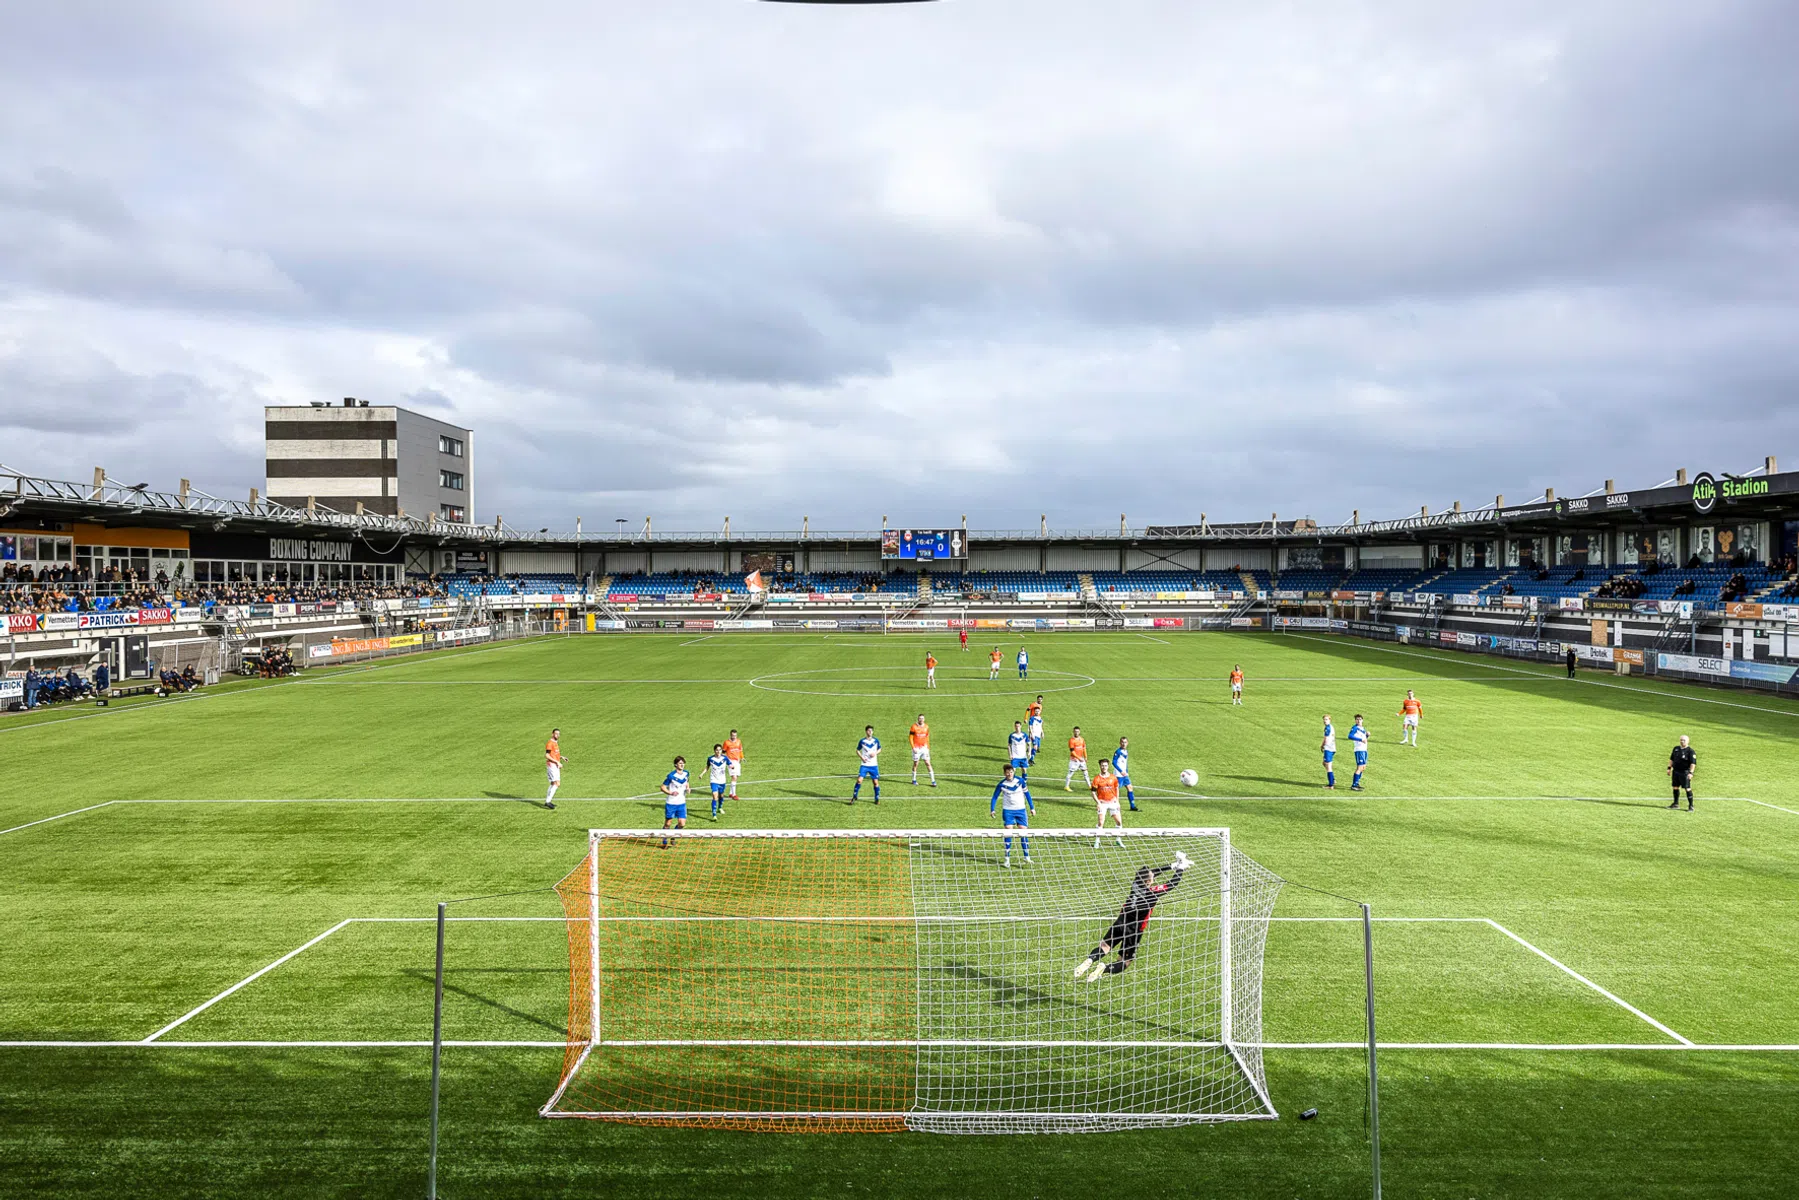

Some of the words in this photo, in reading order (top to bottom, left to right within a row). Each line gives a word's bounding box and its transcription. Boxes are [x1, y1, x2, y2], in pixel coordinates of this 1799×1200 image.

[1692, 482, 1717, 500] Atik
[1722, 477, 1769, 498] Stadion
[1568, 498, 1589, 510] SAKKO
[1607, 493, 1629, 505] SAKKO
[905, 543, 911, 552] 1
[915, 538, 935, 546] 16:47
[937, 543, 945, 552] 0
[309, 541, 353, 561] COMPANY
[48, 615, 77, 624] Vermetten
[89, 614, 125, 628] PATRICK
[142, 609, 168, 621] SAKKO
[353, 643, 364, 653] ING
[1698, 658, 1723, 671] SELECT
